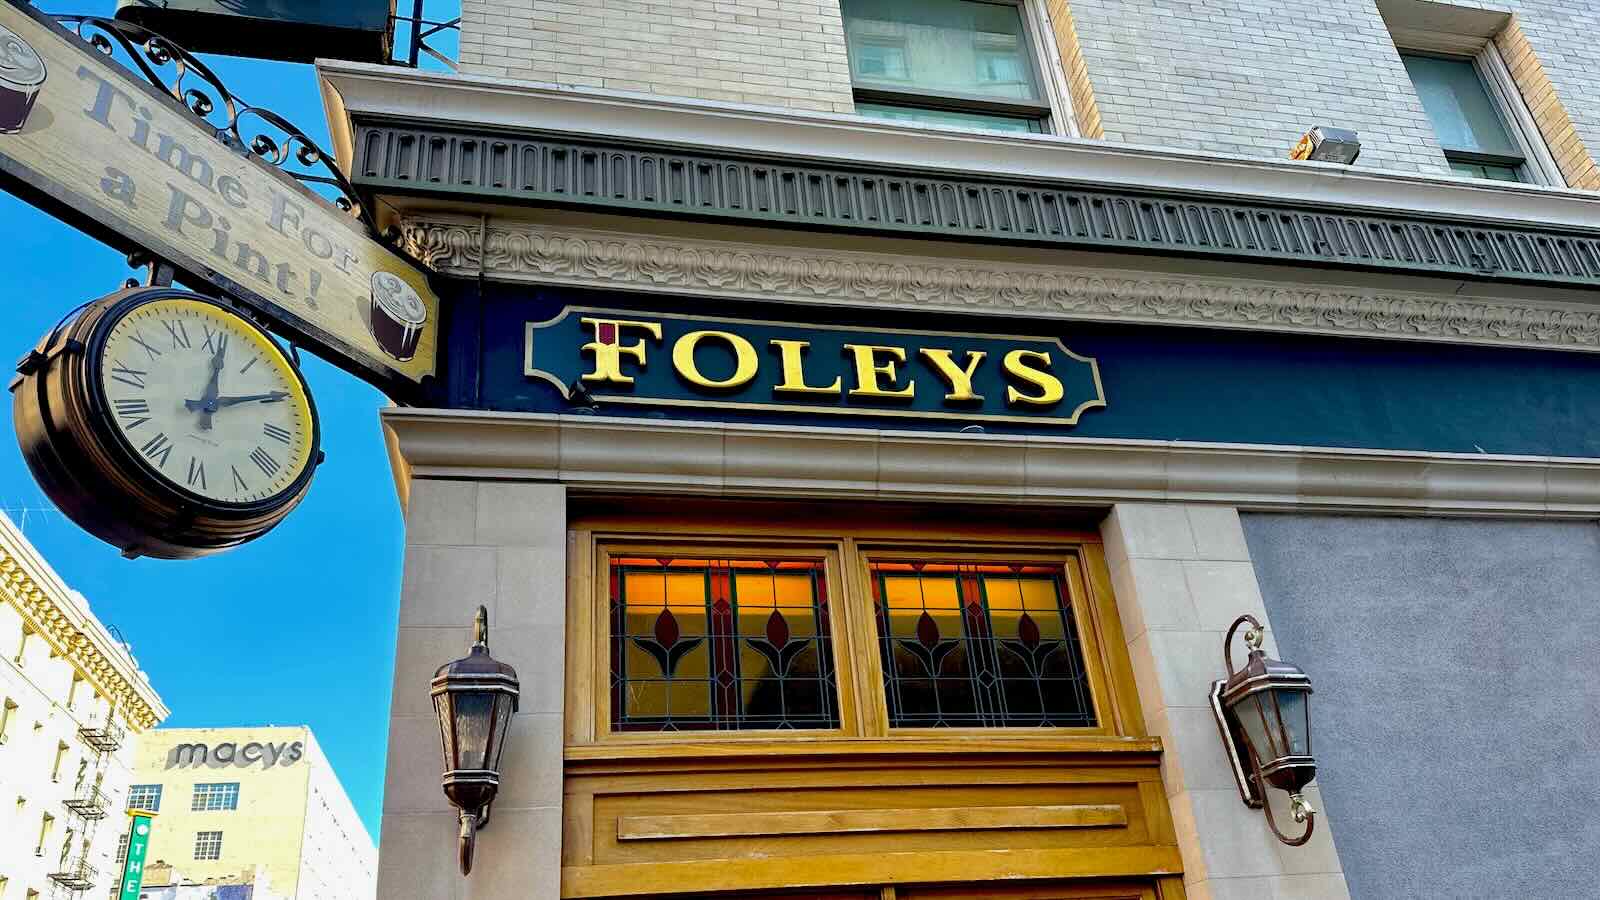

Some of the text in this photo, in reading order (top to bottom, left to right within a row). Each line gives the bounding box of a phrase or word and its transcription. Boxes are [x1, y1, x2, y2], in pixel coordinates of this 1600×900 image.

[77, 65, 359, 275] Time For
[100, 167, 323, 311] a Pint!
[580, 317, 1065, 405] FOLEYS
[126, 843, 144, 893] THE
